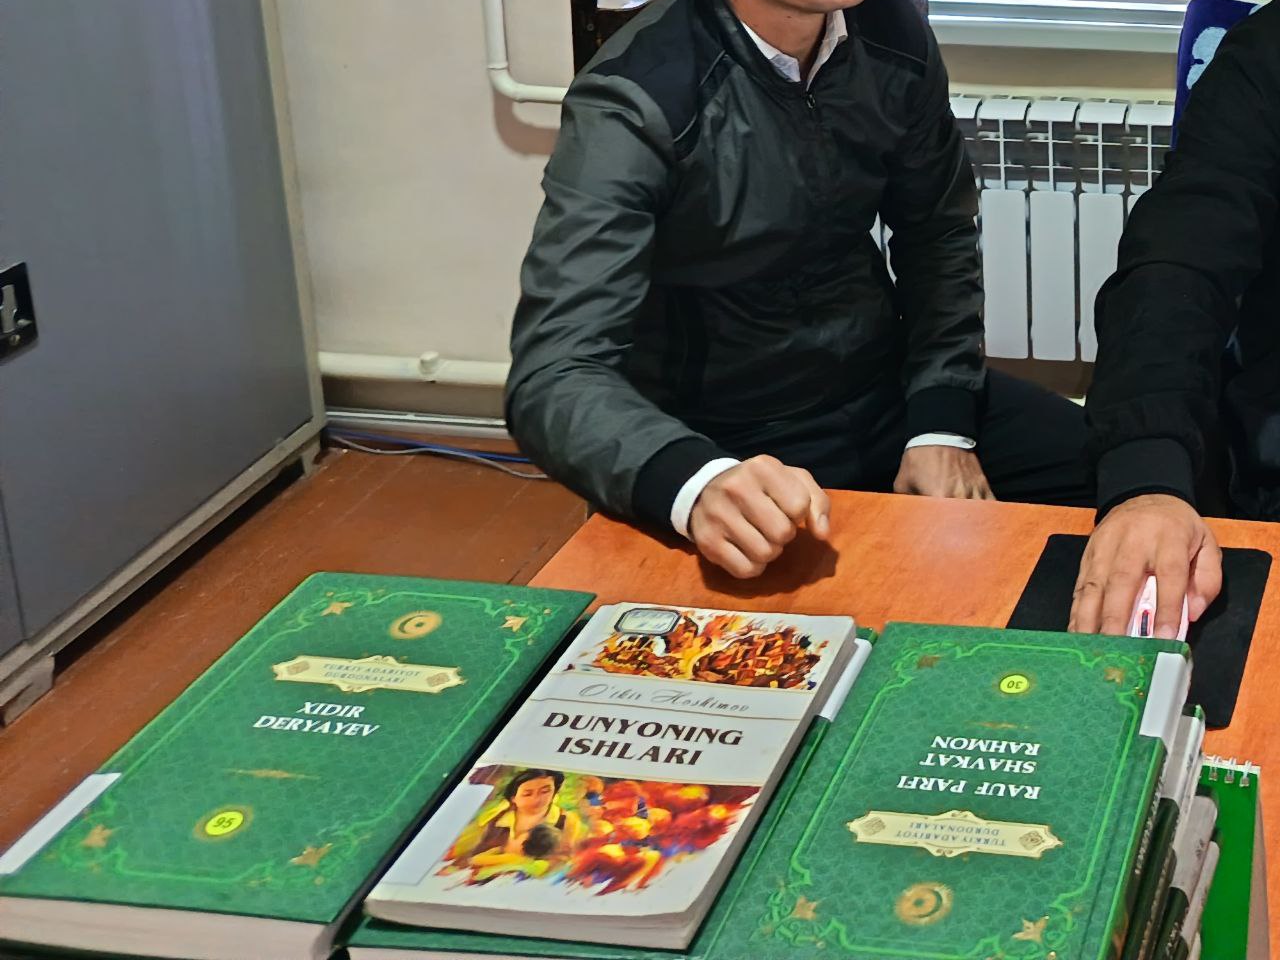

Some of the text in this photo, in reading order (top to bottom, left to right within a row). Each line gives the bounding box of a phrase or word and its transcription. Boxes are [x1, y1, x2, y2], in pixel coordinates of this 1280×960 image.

[296, 701, 366, 719] XIDIR
[253, 714, 381, 737] DERYAYEV
[543, 711, 744, 746] DUNYONING
[556, 737, 703, 766] ISHLARI
[931, 735, 1041, 756] RAHMON
[919, 752, 1037, 774] SHAVKAT
[897, 775, 1041, 800] RAUF PARFI
